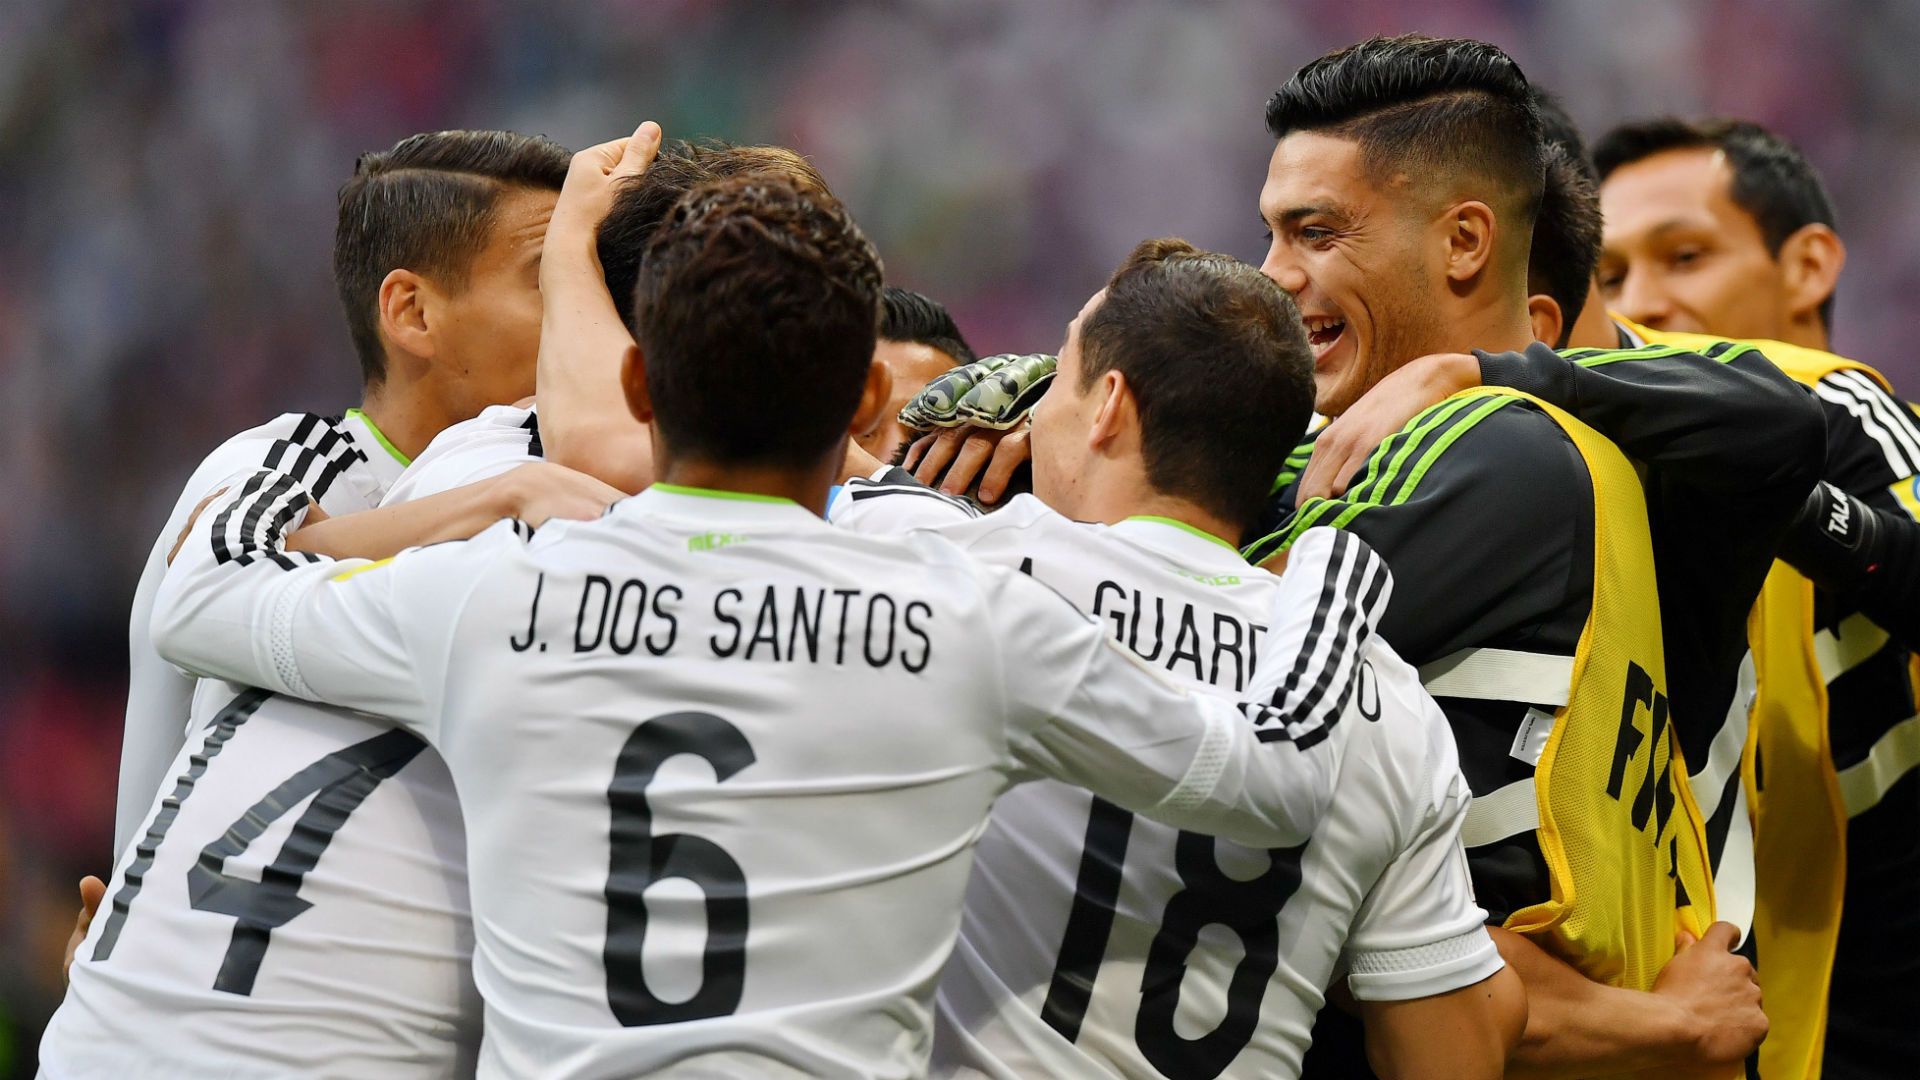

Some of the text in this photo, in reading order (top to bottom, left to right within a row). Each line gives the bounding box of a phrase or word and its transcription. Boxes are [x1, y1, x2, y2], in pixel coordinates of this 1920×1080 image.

[510, 572, 933, 673] J. DOS SANTOS
[90, 686, 429, 997] 14
[604, 711, 757, 1028] 6
[1041, 794, 1310, 1080] 18
